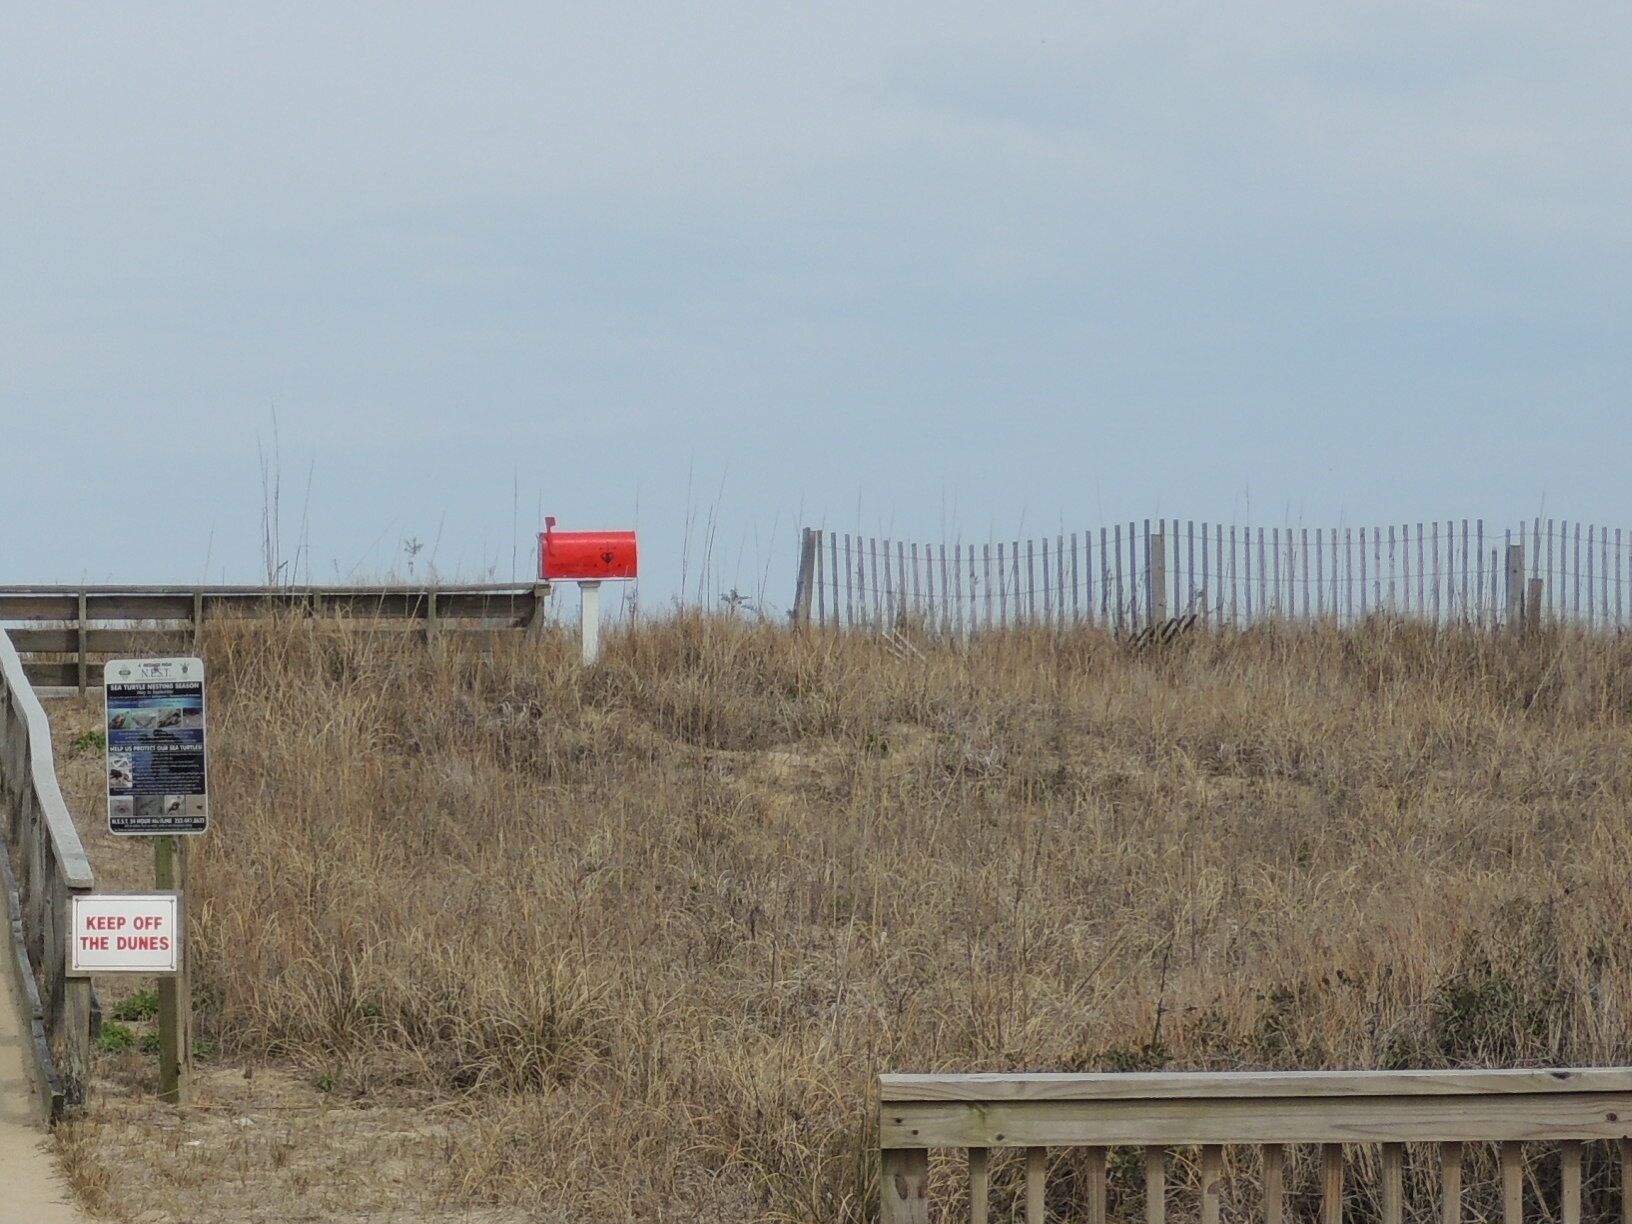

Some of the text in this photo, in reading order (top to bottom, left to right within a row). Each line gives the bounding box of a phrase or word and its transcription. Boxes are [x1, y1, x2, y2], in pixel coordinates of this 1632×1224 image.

[86, 916, 163, 930] KEEP OFF
[80, 936, 169, 951] THE DUNES
